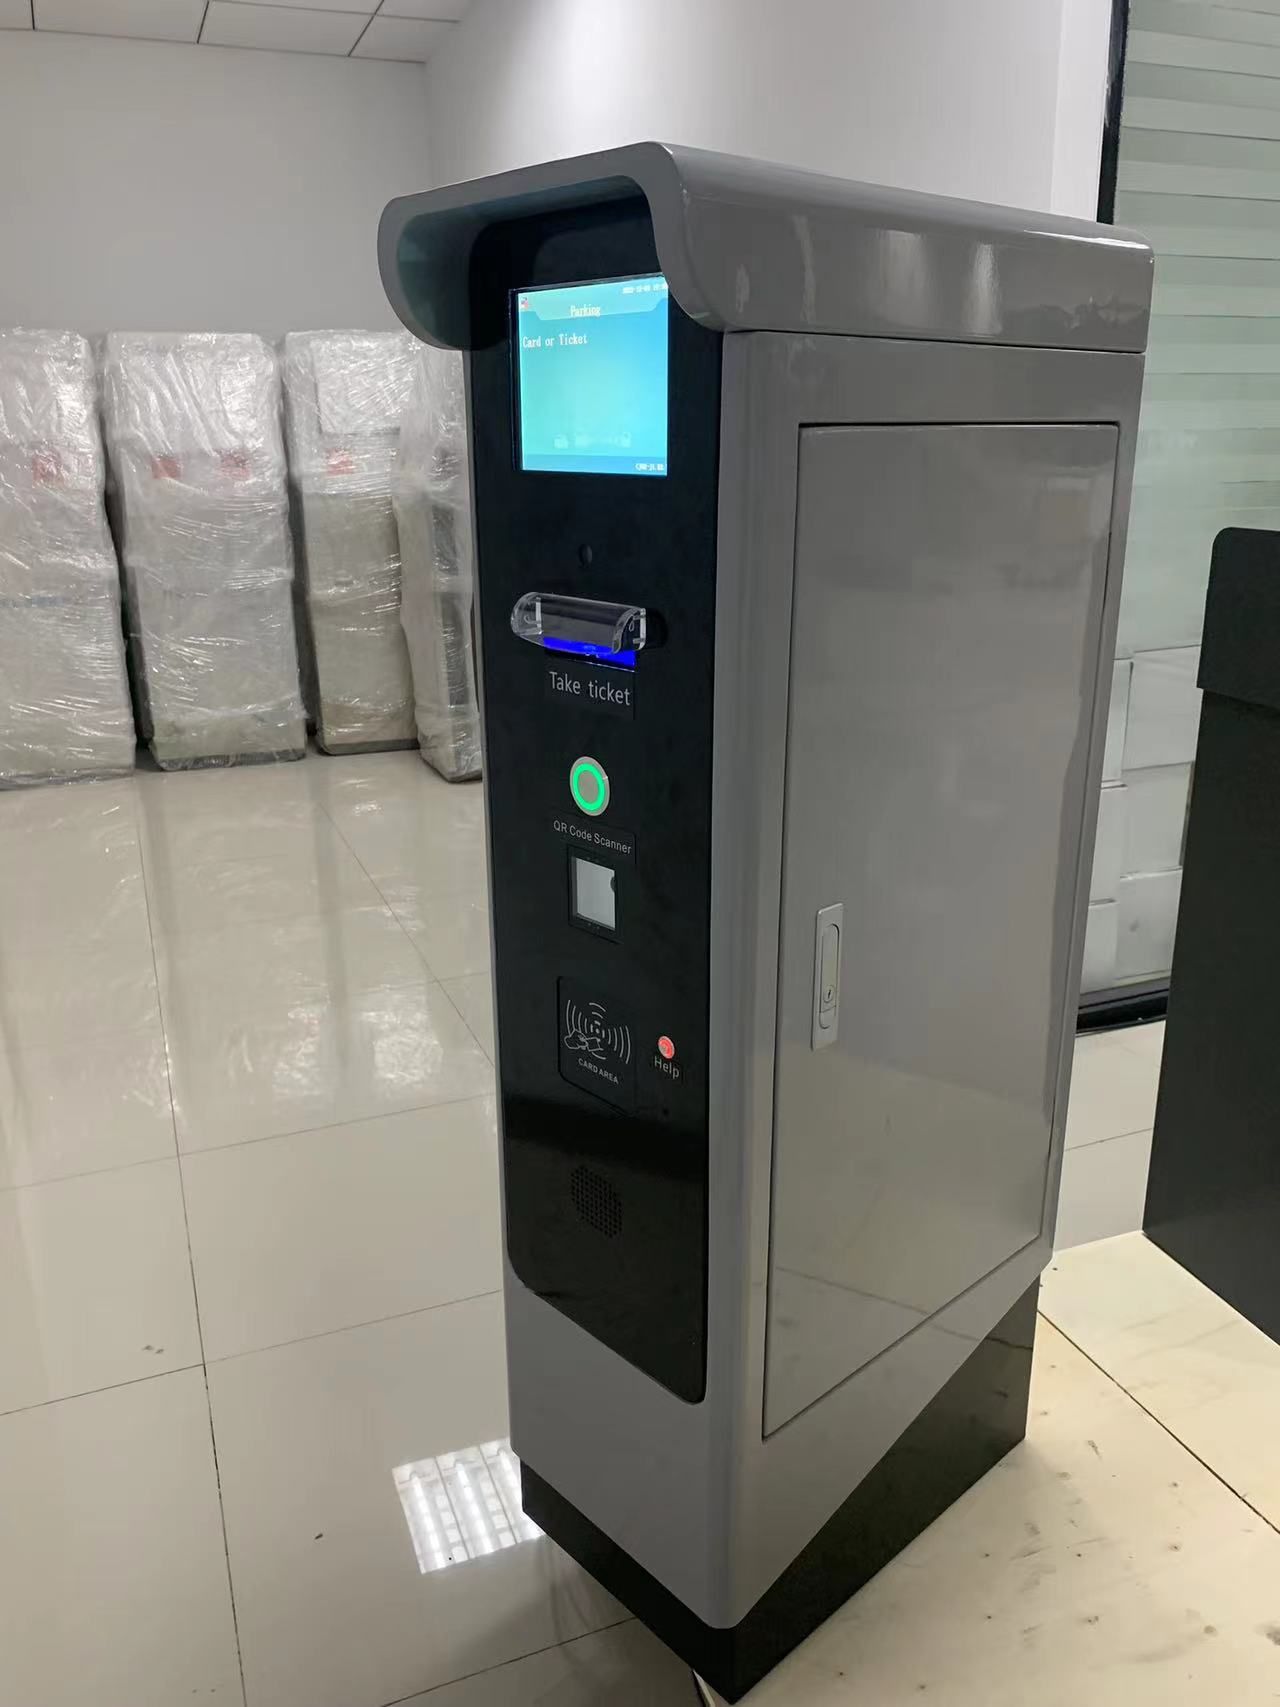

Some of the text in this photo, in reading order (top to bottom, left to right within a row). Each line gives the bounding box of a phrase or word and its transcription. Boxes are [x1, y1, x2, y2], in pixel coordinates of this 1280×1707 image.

[523, 333, 587, 348] Card or Ticket
[549, 671, 631, 706] Take ticket
[553, 820, 632, 854] QR Code Scanner
[578, 1058, 618, 1084] CARD AREA
[654, 1056, 680, 1079] Help
